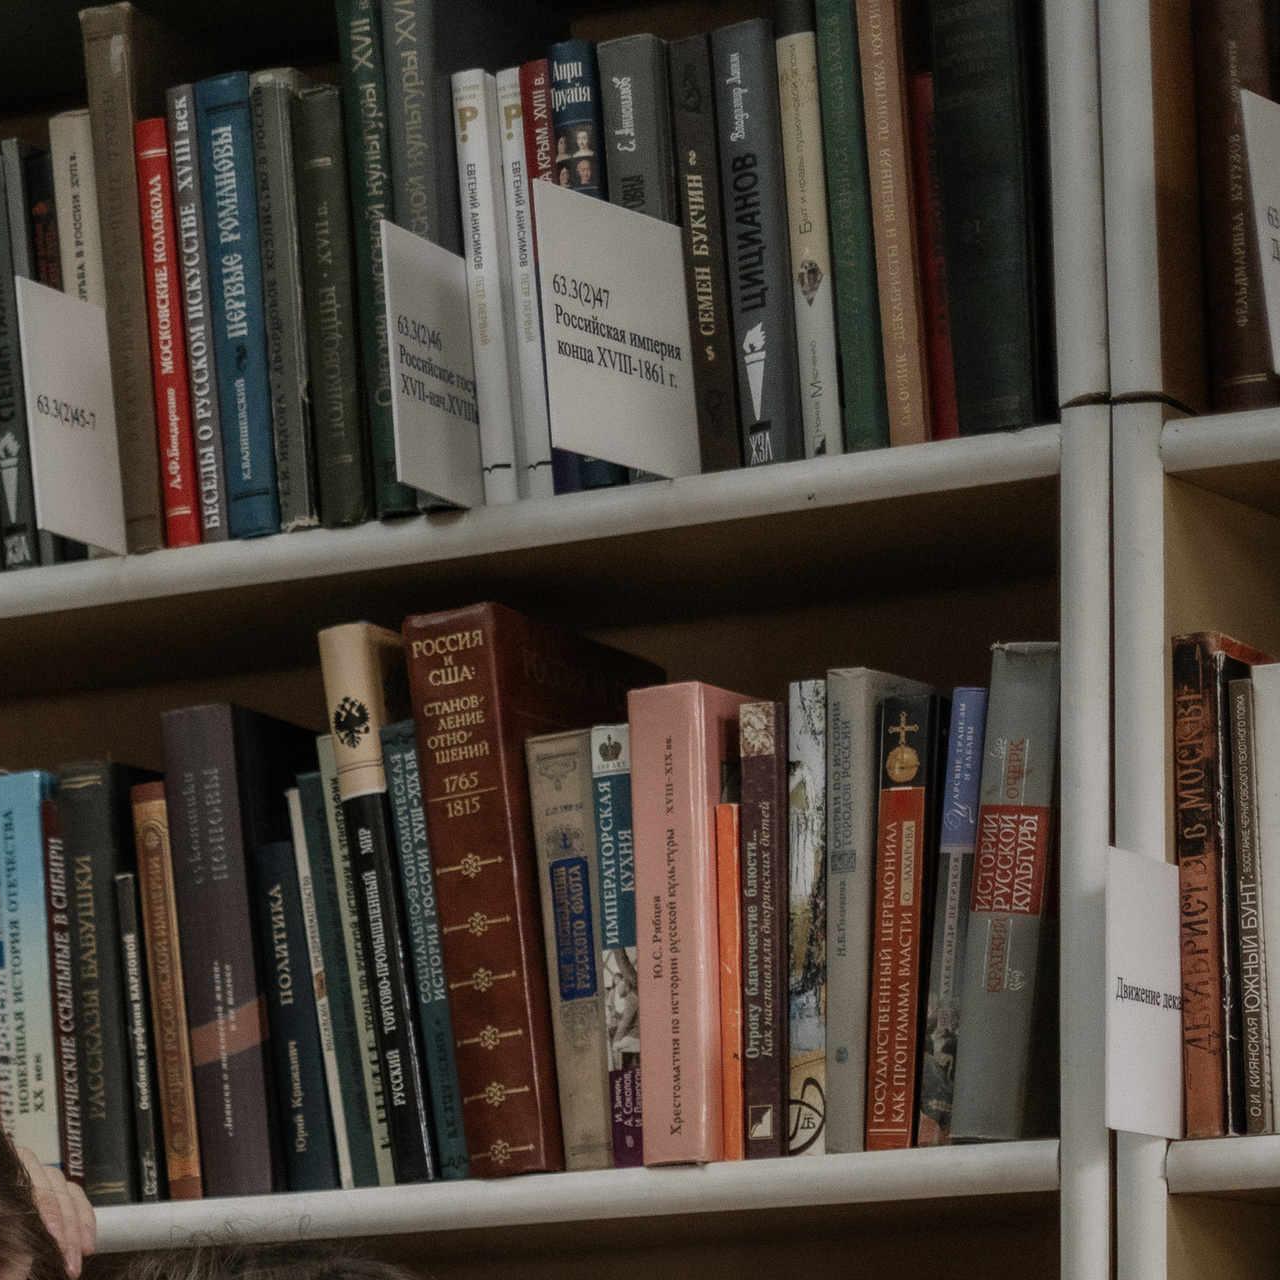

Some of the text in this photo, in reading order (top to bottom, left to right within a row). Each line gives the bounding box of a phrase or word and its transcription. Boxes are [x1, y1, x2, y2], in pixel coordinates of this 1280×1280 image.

[725, 51, 749, 141] Владимир Лапин
[146, 173, 174, 374] МОСКОВСКИЕ КОЛОКОЛА
[210, 124, 248, 338] ПЕРВЫЕ РОМАНОВЫ
[686, 173, 715, 335] СЕМЕН БУКЧИН
[730, 152, 769, 312] ЦИЦИАНОВ
[1228, 133, 1250, 326] ФЕЛЬДМАРШАЛ КУТУЗОВ
[172, 95, 222, 528] БЕСЕДЫ О РУССКОМ ИСКУССТВЕ XVIII век
[397, 314, 442, 352] 63.3(2)46
[552, 273, 610, 309] 63.3(2)47
[554, 303, 682, 362] Российская империя
[557, 339, 678, 389] конца XVIII-1861 г.
[749, 432, 773, 467] ЖЗЛ
[412, 629, 484, 660] РОССИЯ
[428, 665, 476, 687] США:
[423, 695, 486, 717] СТАНОВ-
[426, 730, 474, 750] ОТНО-
[437, 710, 486, 732] ЛЕНИЕ
[435, 741, 490, 765] ШЕНИЙ
[442, 770, 479, 794] 1765
[1002, 737, 1026, 799] ОЧЕРК
[446, 796, 481, 819] 1815
[596, 781, 619, 944] ИМПЕРАТОРСКАЯ
[616, 829, 636, 892] КУХНЯ
[902, 824, 914, 901] О. ЗАХАРОВА
[974, 812, 1000, 911] ИСТОРИИ
[990, 813, 1018, 911] РУССКОЙ
[1009, 813, 1040, 911] КУЛЬТУРЫ
[0, 809, 29, 1113] НОВЕЙШАЯ ИСТОРИЯ ОТЕЧЕСТВА
[266, 883, 294, 1005] ПОЛИТИКА
[357, 827, 405, 1106] РУССКИЙ ТОРГОВО-ПРОМЫШЛЕННЫЙ МИР
[650, 895, 664, 978] Ю.С. Рябцев
[742, 829, 762, 1058] Отроку благочестие блюсти...
[758, 801, 774, 1057] Как наставляли дворянских детей
[871, 820, 899, 1122] ГОСУДАРСТВЕННЫЙ ЦЕРЕМОНИАЛ
[984, 915, 1008, 993] КРАТКИЙ
[48, 837, 83, 1176] ПОЛИТИЧЕСКИЕ ССЫЛЬНЫЕ В СИБИРИ
[74, 856, 105, 1119] РАССКАЗЫ БАБУШКИ
[891, 912, 912, 1122] КАК ПРОГРАММА ВЛАСТИ
[1116, 976, 1161, 1007] Движение
